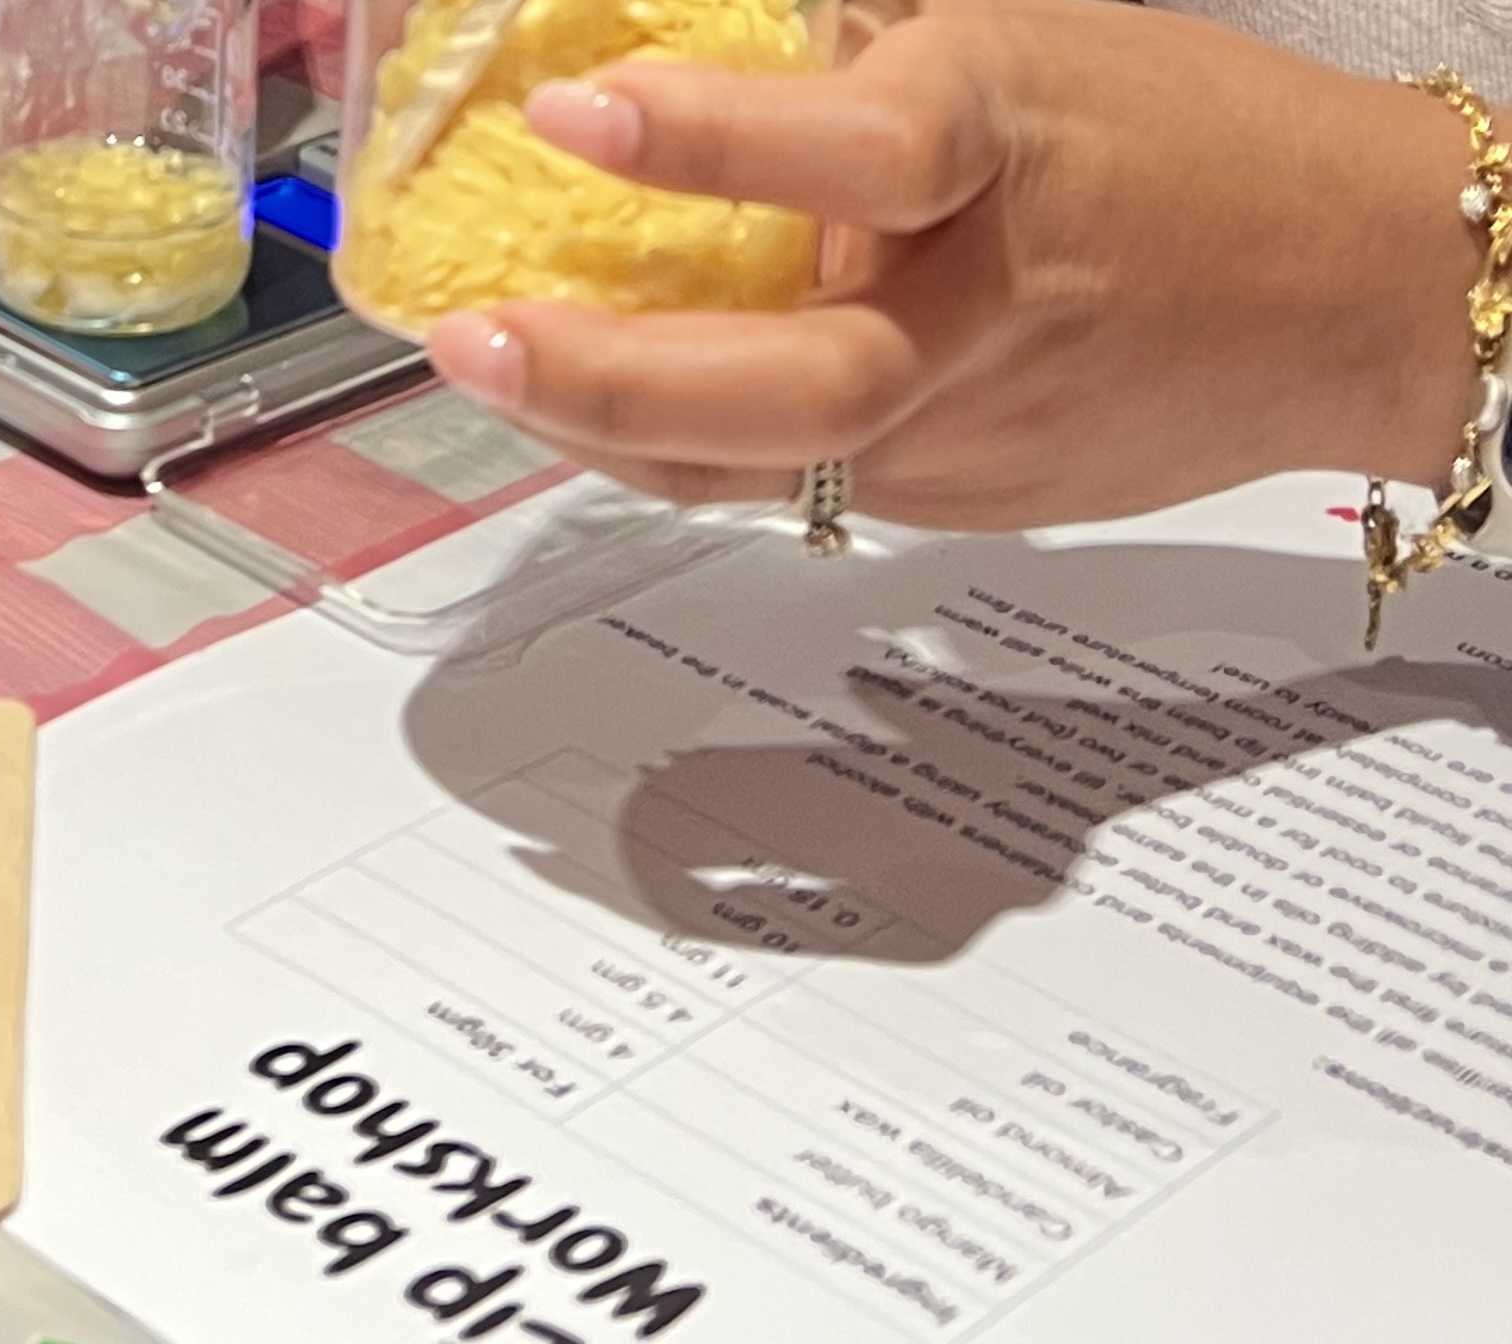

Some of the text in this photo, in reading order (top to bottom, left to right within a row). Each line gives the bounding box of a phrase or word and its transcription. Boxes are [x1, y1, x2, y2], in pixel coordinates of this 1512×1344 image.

[934, 605, 999, 637] warm
[681, 656, 718, 676] the
[1048, 656, 1111, 686] while
[1072, 634, 1219, 701] temperature
[1211, 664, 1269, 689] use!
[748, 689, 810, 719] scale
[977, 691, 1022, 713] not
[1273, 688, 1300, 704] to
[1021, 711, 1077, 739] (but
[1166, 707, 1230, 740] balm
[1223, 699, 1292, 731] room
[943, 708, 1072, 771] everything
[1123, 722, 1171, 746] mix
[1234, 737, 1267, 756] lip
[1292, 728, 1324, 744] at
[1384, 735, 1442, 761] now
[889, 753, 909, 764] a
[1078, 737, 1125, 762] two
[1169, 745, 1225, 770] and
[911, 763, 980, 801] using
[1127, 762, 1158, 775] or
[1162, 775, 1253, 817] minute
[1325, 776, 1393, 811] balm
[1256, 816, 1276, 827] a
[1263, 786, 1386, 841] essential
[1112, 825, 1185, 861] same
[1197, 826, 1288, 870] double
[1280, 829, 1319, 849] for
[1389, 842, 1421, 856] or
[1477, 844, 1511, 867] he
[1190, 860, 1235, 886] the
[1291, 871, 1323, 887] or
[1387, 875, 1417, 894] to
[1120, 868, 1201, 910] butter
[1240, 884, 1268, 901] in
[712, 902, 766, 931] gm
[1094, 894, 1153, 922] and
[1202, 907, 1260, 935] and
[1329, 887, 1482, 960] microwave
[660, 935, 714, 964] gm
[1266, 935, 1322, 966] wax
[1327, 922, 1425, 971] adding
[591, 961, 645, 991] gm
[1157, 923, 1318, 1004] equipments
[1329, 965, 1377, 993] the
[558, 1009, 631, 1057] 4 gm
[1326, 1005, 1373, 1033] the
[427, 1002, 574, 1097] For 30gm
[1068, 1031, 1237, 1125] Fragrance
[838, 1100, 900, 1139] wax
[1021, 1072, 1182, 1161] Castor oil
[950, 1098, 1131, 1198] Almond oil
[162, 1110, 405, 1273] balm
[251, 1042, 701, 1336] Workshop
[794, 1150, 1015, 1283] Mango butter
[756, 1198, 955, 1323] Ingredients
